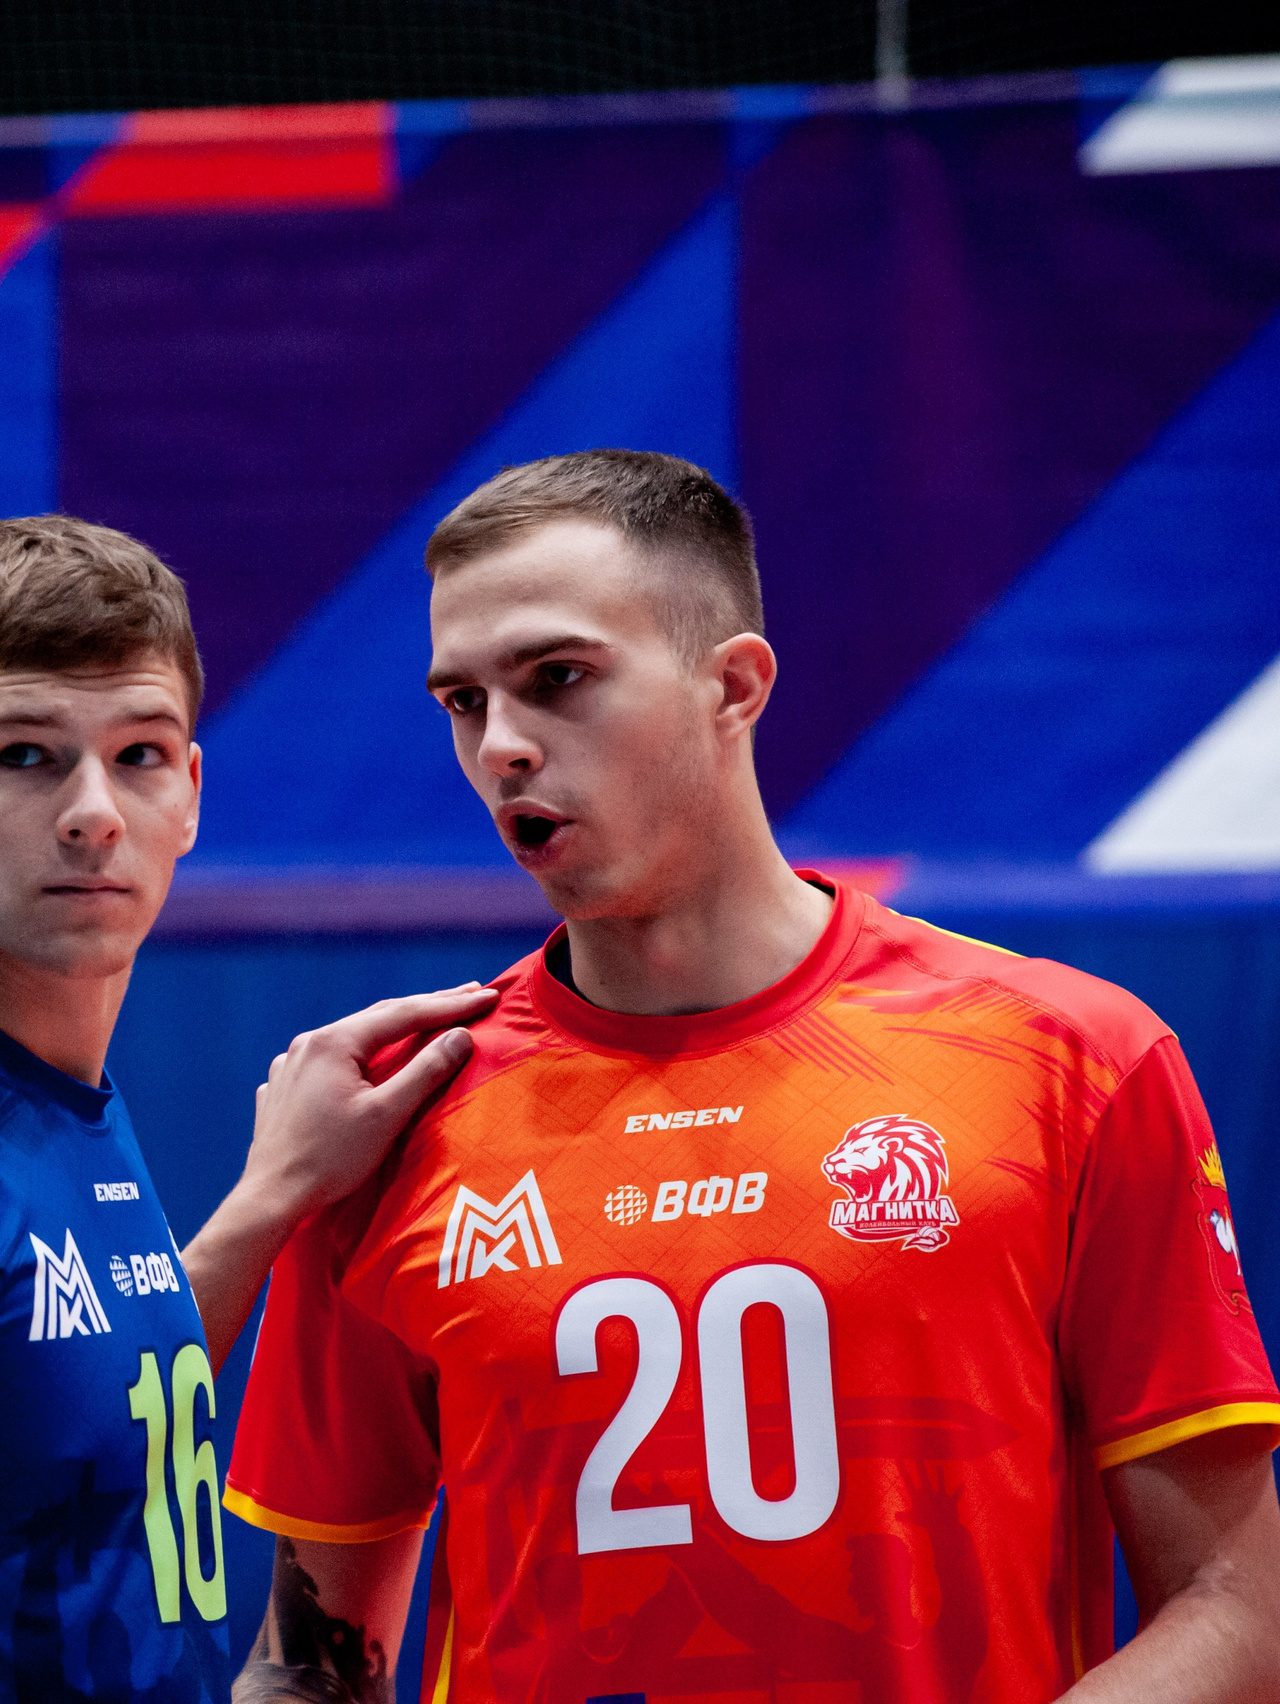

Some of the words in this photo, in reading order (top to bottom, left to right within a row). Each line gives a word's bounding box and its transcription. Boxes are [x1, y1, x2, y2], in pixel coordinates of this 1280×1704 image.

[625, 1106, 743, 1133] ENSEN
[93, 1182, 140, 1202] ENSEN
[651, 1172, 768, 1222] ВФВ
[832, 1199, 956, 1225] МАГНИТКА
[129, 1252, 180, 1296] ВФВ
[555, 1264, 840, 1555] 20
[128, 1344, 227, 1624] 16
